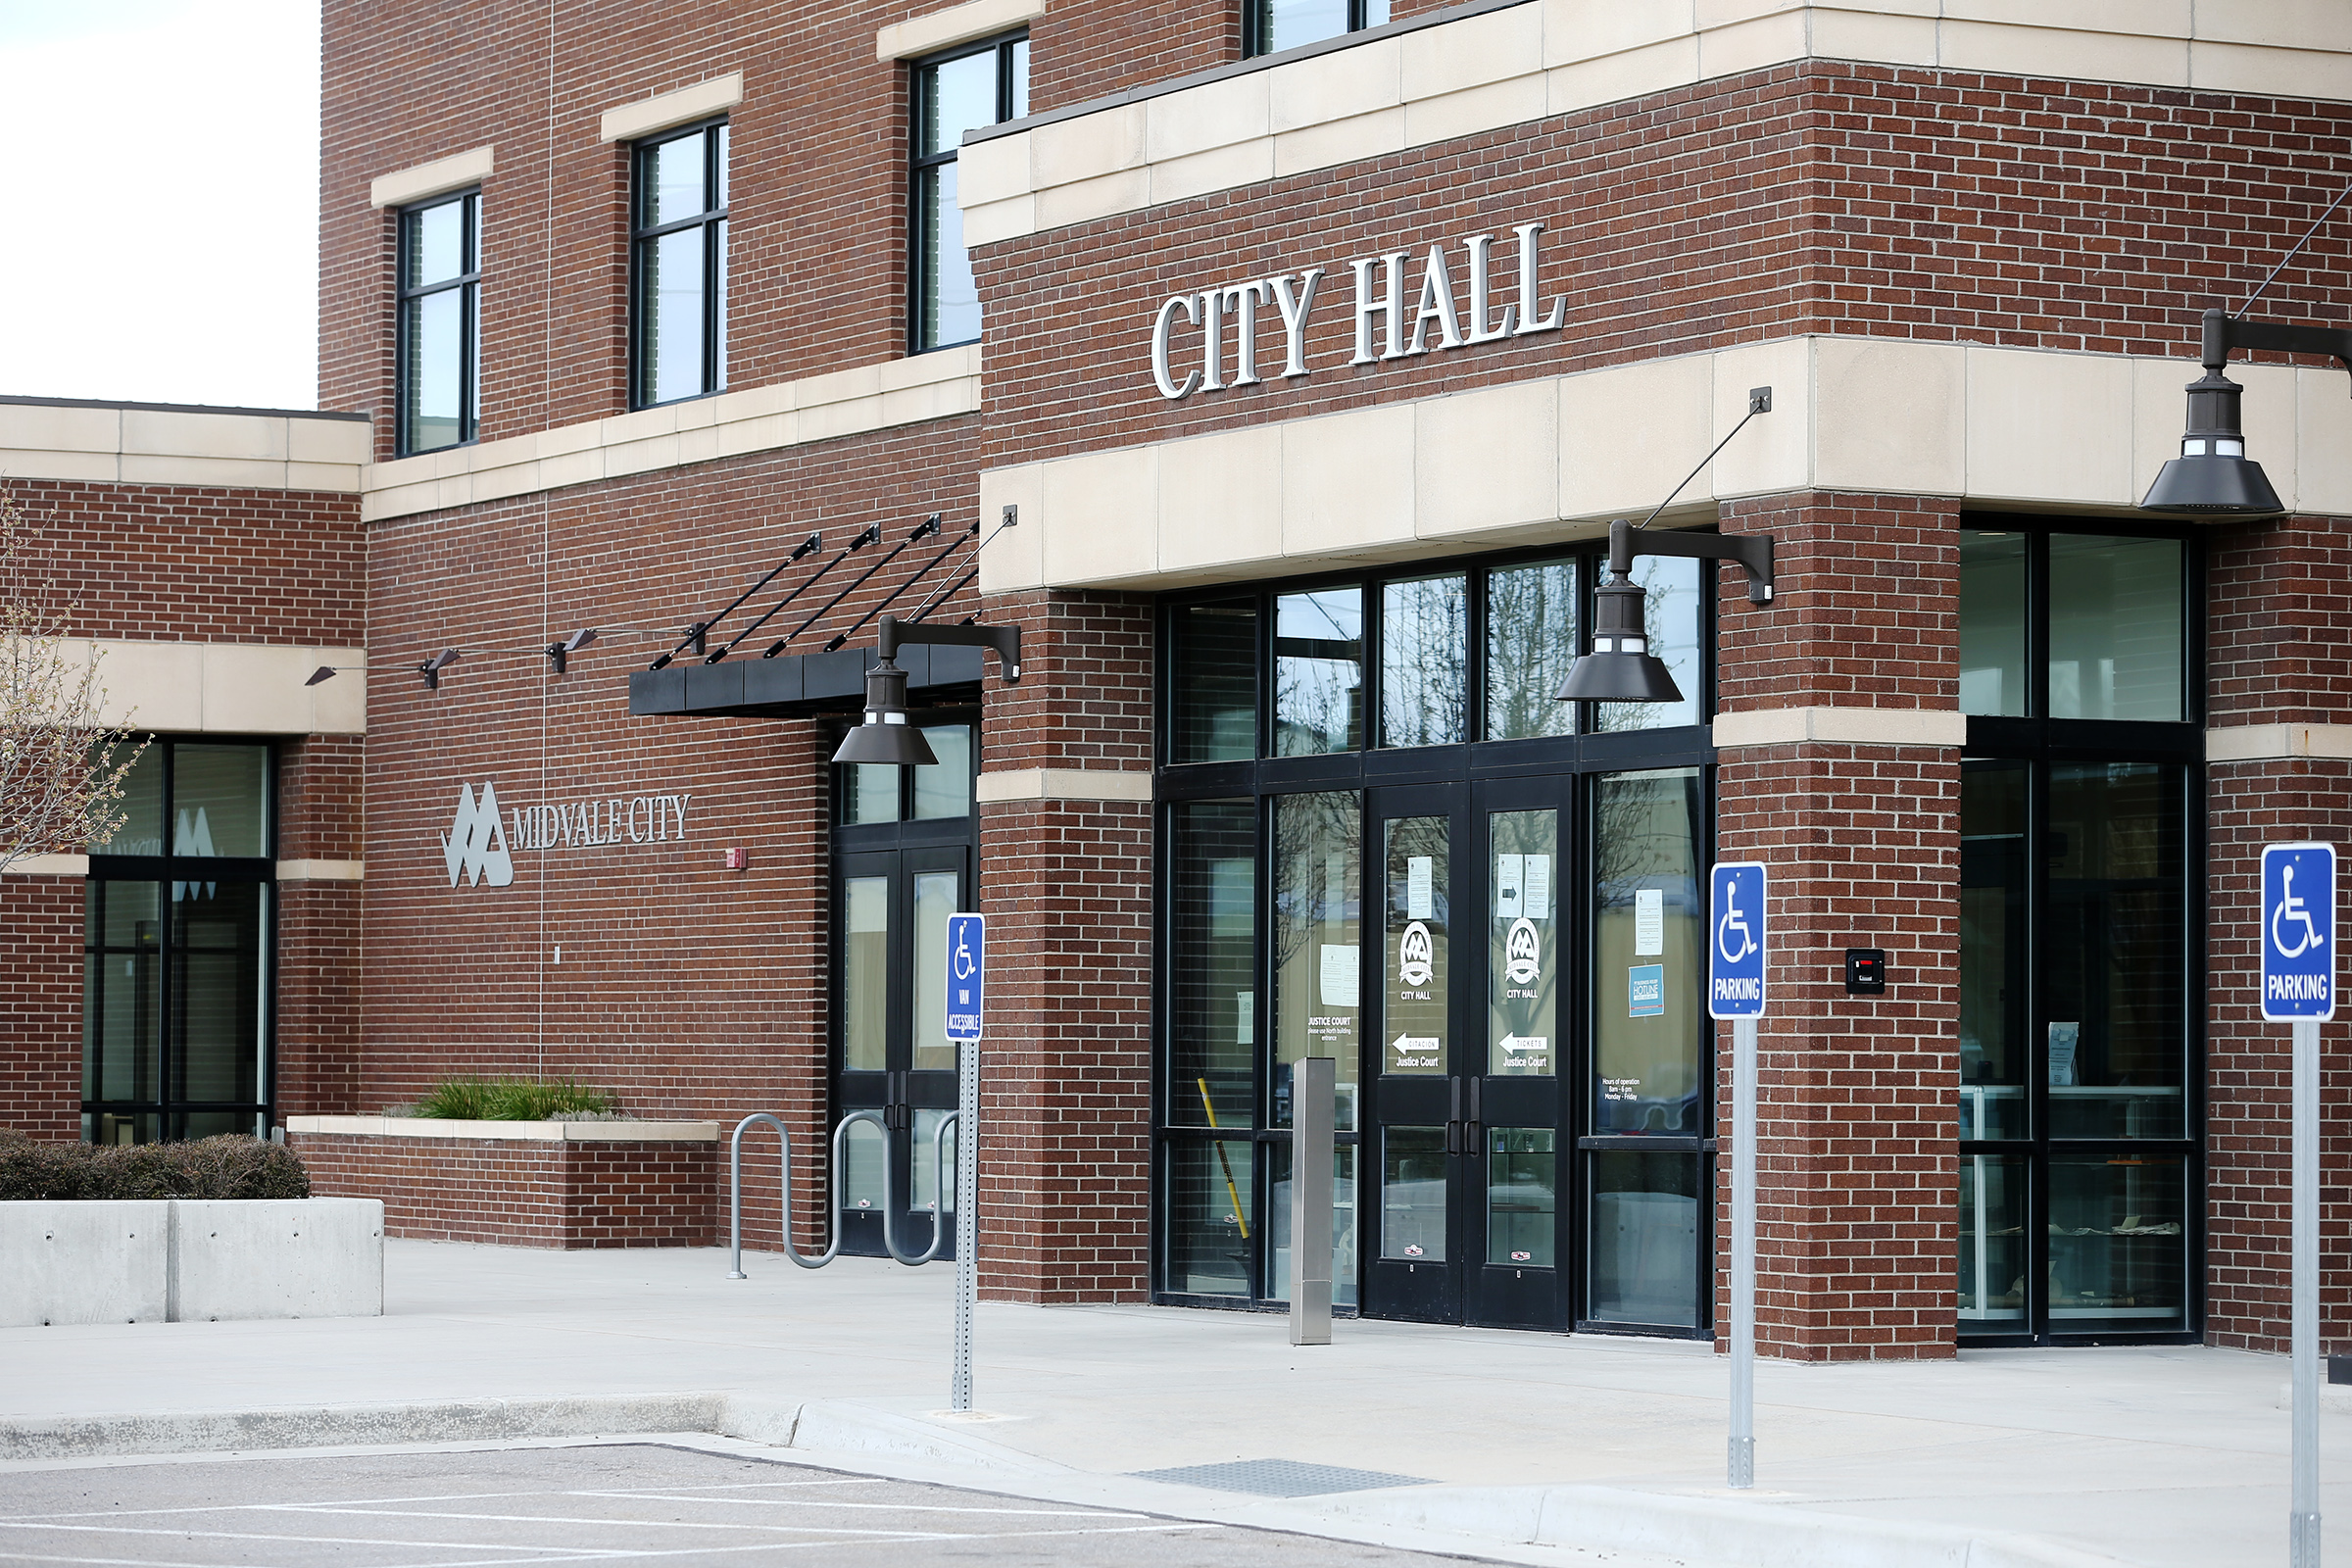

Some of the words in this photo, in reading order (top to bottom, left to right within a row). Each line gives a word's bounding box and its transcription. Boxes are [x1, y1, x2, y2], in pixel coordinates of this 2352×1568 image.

[1152, 268, 1326, 399] CITY
[1348, 222, 1566, 366] HALL
[512, 799, 623, 851] MIDVALE
[628, 794, 692, 843] CITY
[1633, 984, 1658, 996] HOTLINE
[1715, 977, 1760, 1001] PARKING
[2268, 973, 2328, 1001] PARKING
[958, 989, 970, 1005] VAN
[1400, 991, 1415, 1000] CITY
[1415, 991, 1431, 1000] HALL
[1506, 989, 1521, 999] CITY
[1521, 989, 1538, 999] HALL
[948, 1013, 980, 1030] ACCESSIBLE
[1308, 1016, 1331, 1026] JUSTICE
[1331, 1016, 1351, 1026] COURT
[1408, 1039, 1436, 1048] CITACIÓN
[1396, 1055, 1420, 1067] Justice
[1420, 1055, 1439, 1067] Court
[1502, 1055, 1527, 1067] Justice
[1527, 1055, 1547, 1067] Court
[1604, 1093, 1621, 1102] Monday
[1624, 1093, 1638, 1102] Friday
